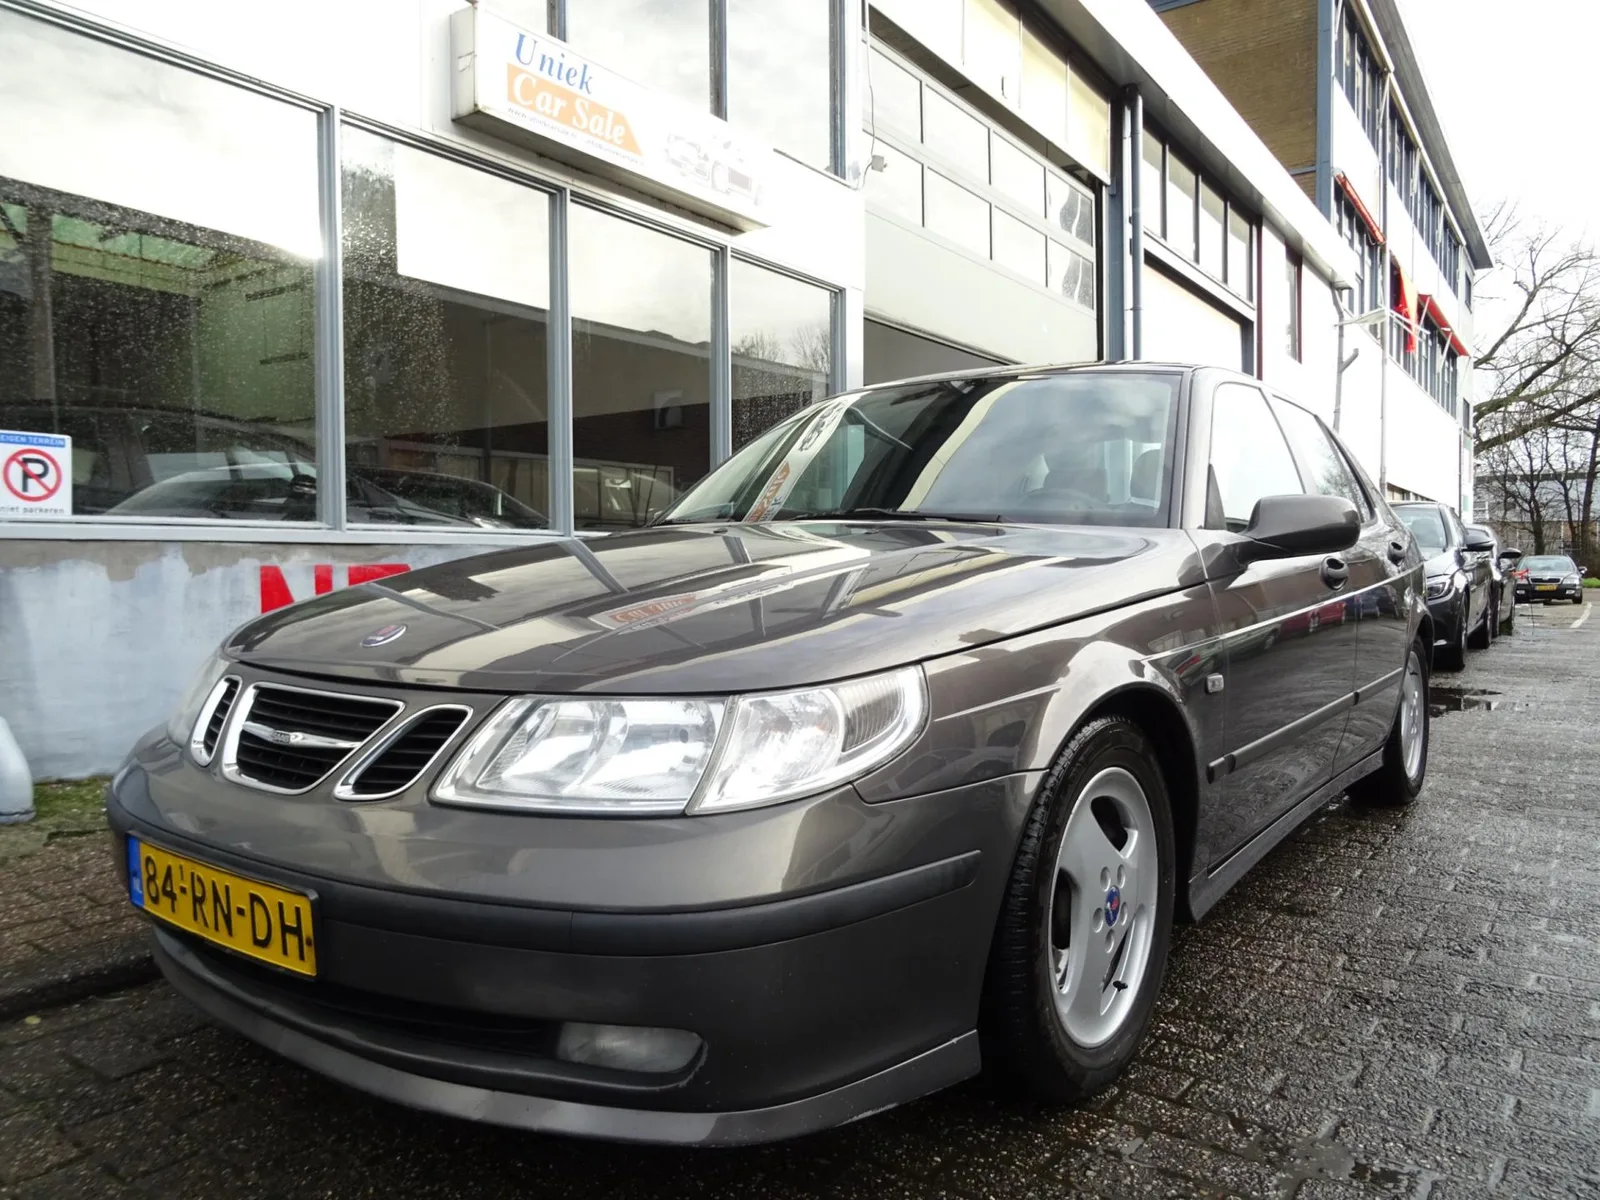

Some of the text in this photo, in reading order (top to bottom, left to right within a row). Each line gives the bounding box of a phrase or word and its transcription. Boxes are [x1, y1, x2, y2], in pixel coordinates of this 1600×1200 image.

[516, 32, 592, 95] Uniek
[513, 72, 567, 118] Car
[572, 96, 626, 145] Sale
[28, 435, 65, 446] TERREIN
[23, 506, 65, 515] parkeren
